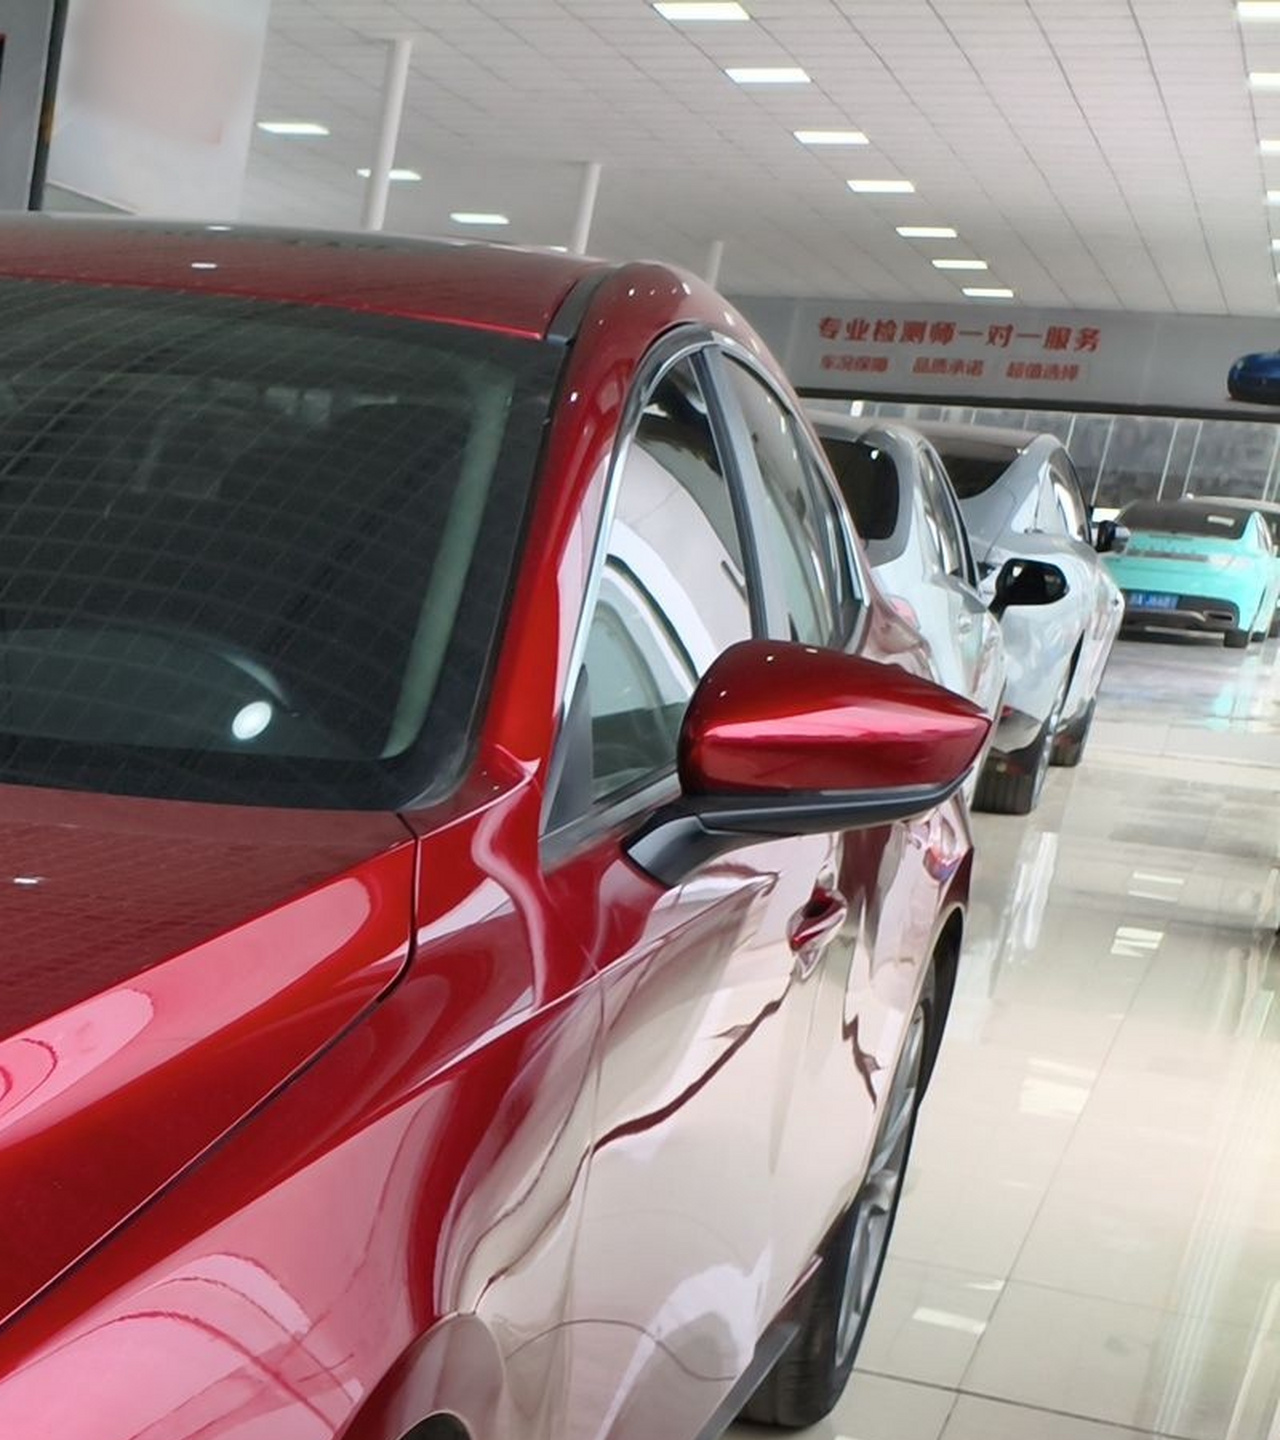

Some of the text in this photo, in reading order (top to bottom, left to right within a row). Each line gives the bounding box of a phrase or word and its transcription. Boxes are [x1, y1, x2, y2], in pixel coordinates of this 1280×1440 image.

[819, 316, 1101, 352] 专业检测师一对一服务
